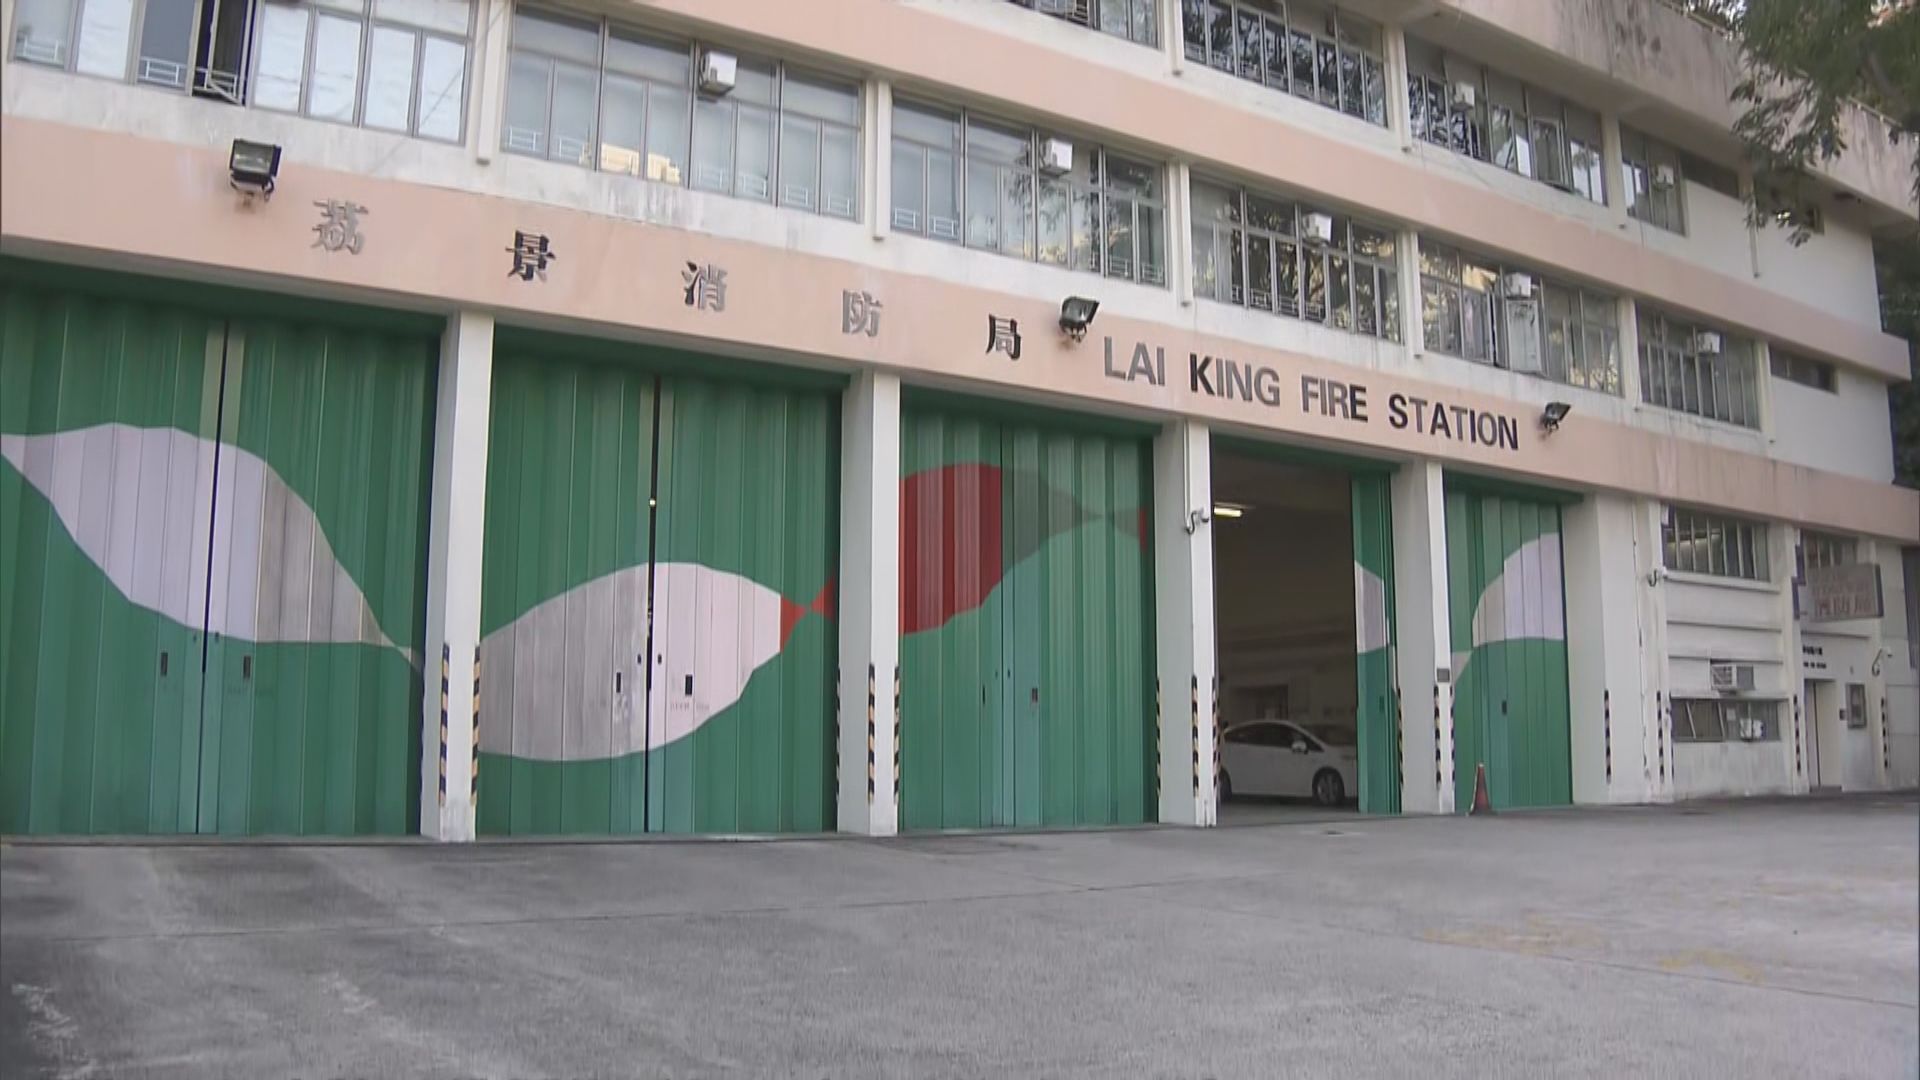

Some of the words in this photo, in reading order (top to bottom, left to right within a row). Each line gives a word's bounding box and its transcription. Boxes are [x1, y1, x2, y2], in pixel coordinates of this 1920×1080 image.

[1104, 336, 1166, 387] LAI
[1189, 352, 1281, 407] KING
[1301, 374, 1369, 423] FIRE
[1388, 393, 1519, 450] STATION
